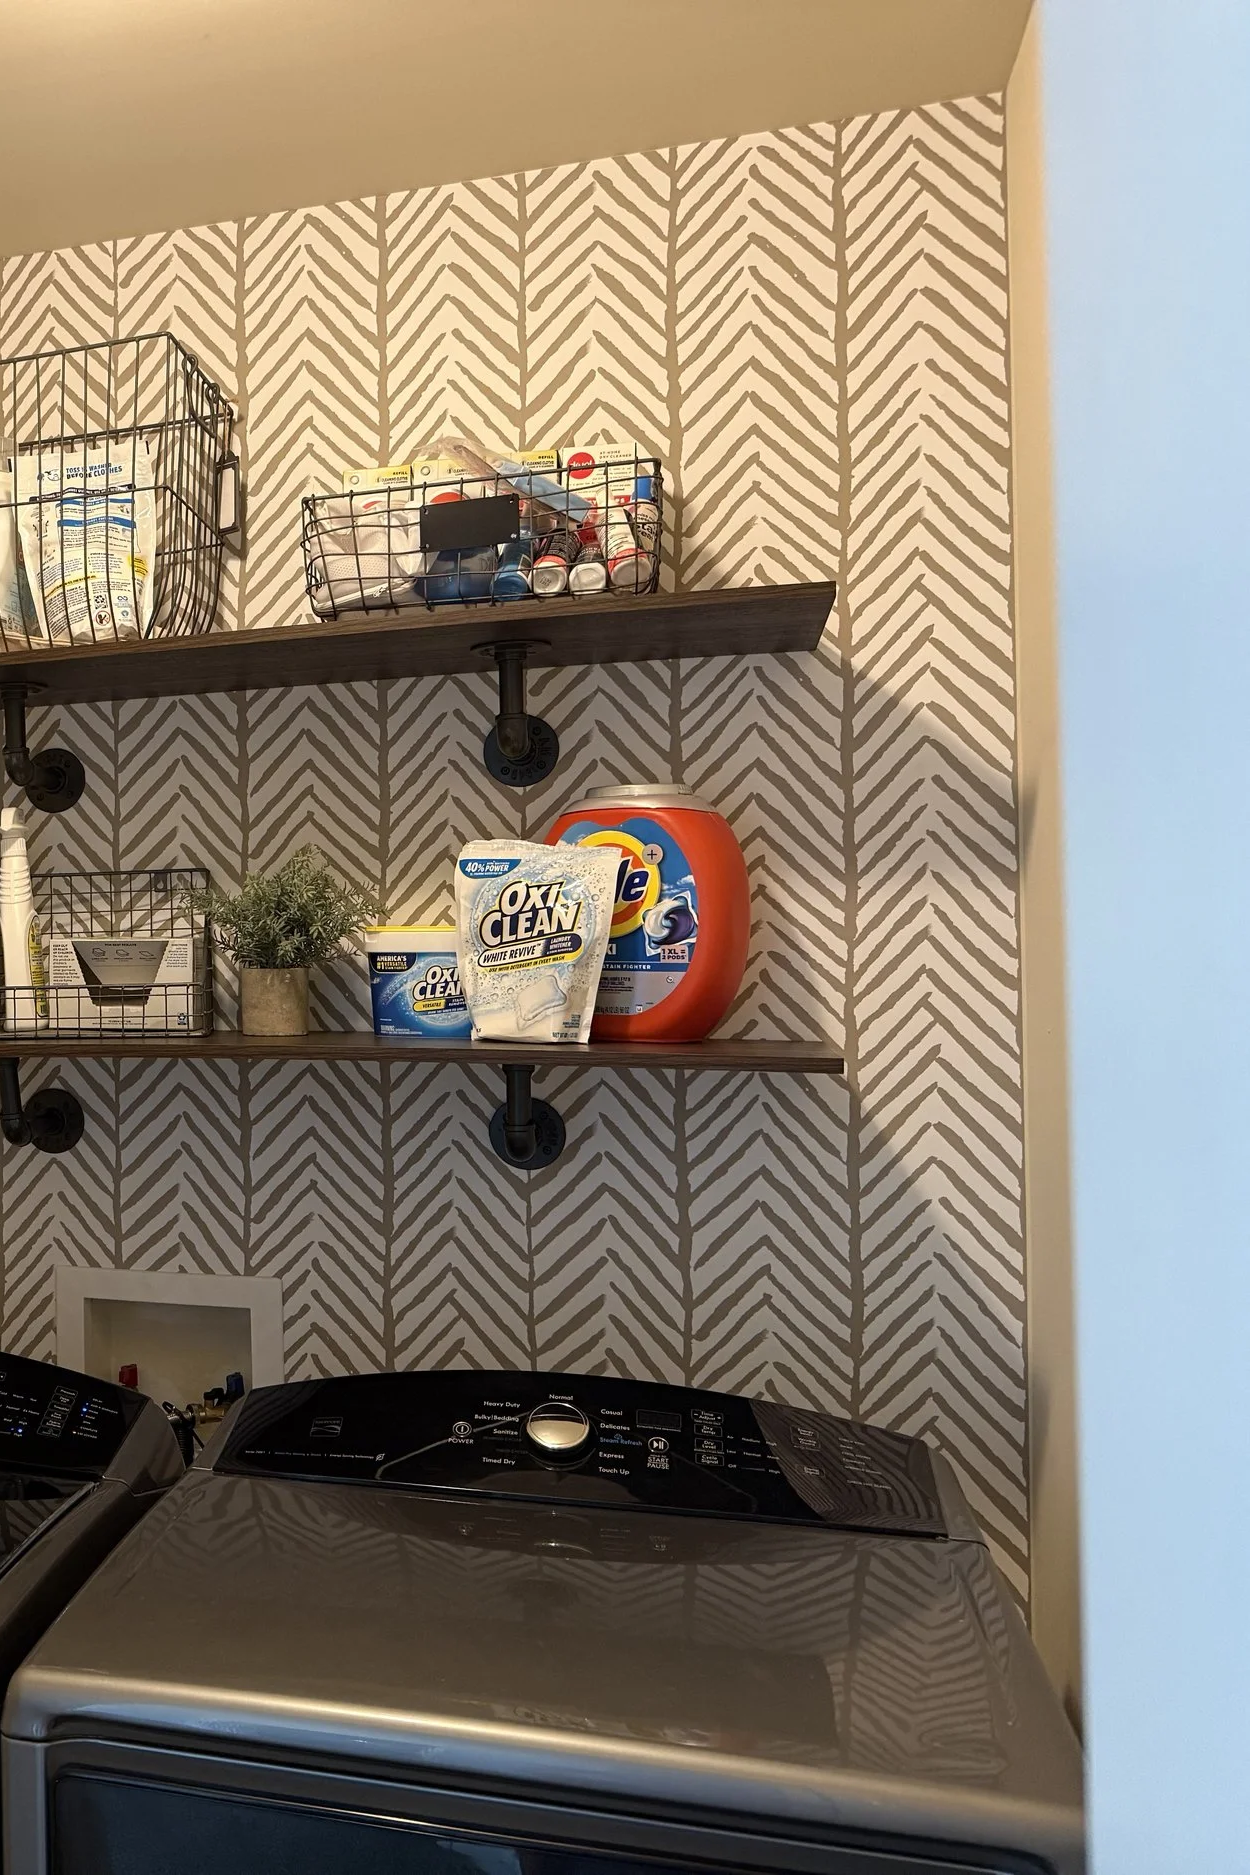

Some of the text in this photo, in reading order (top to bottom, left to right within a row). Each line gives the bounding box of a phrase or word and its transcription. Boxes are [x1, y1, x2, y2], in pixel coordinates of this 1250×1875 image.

[94, 465, 123, 477] CLOHES
[465, 862, 485, 873] 40%
[499, 881, 566, 916] OXI
[479, 901, 582, 948] CLEAN
[483, 950, 508, 964] WHITE
[509, 945, 536, 960] REVIVE
[600, 1408, 623, 1416] Casual
[600, 1423, 630, 1431] Delicates
